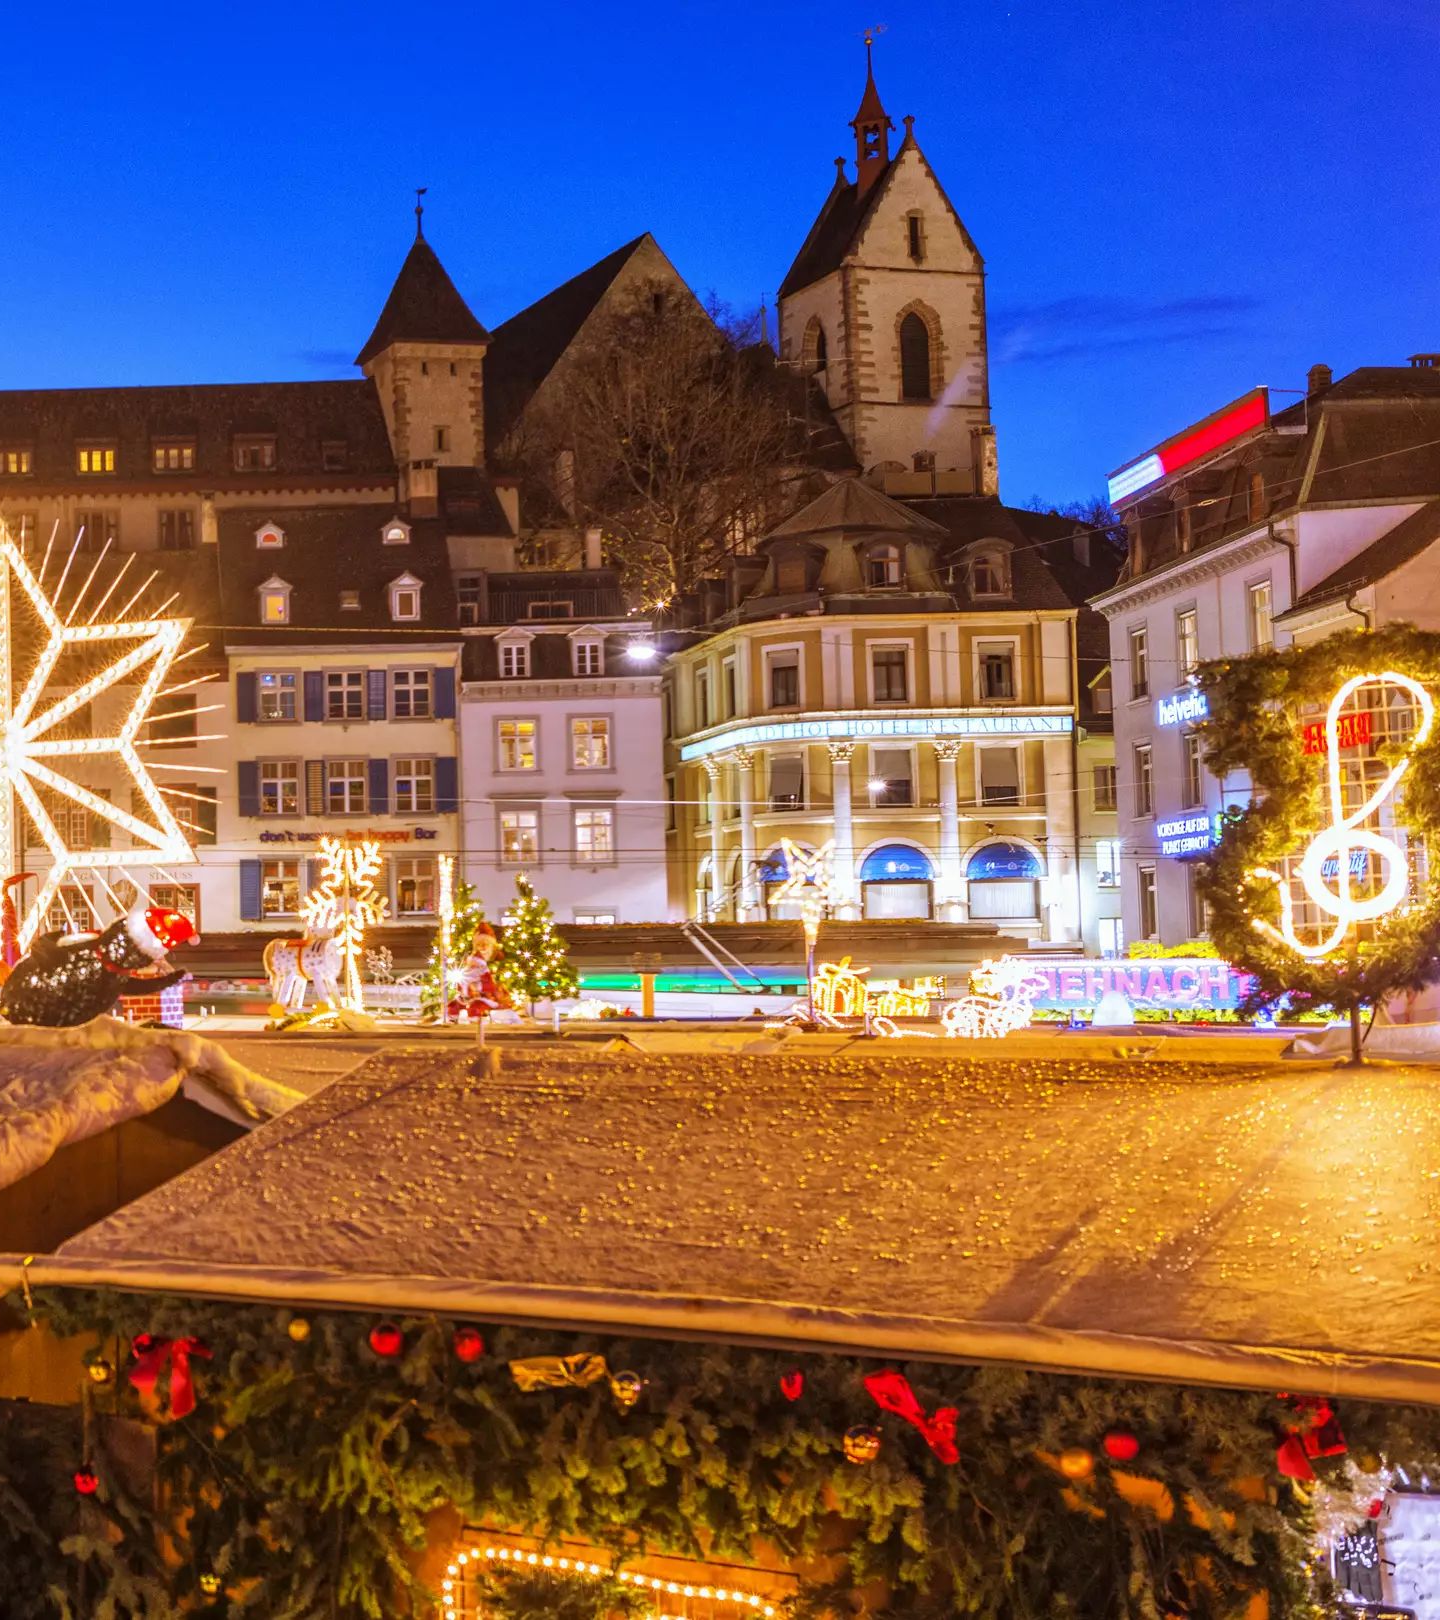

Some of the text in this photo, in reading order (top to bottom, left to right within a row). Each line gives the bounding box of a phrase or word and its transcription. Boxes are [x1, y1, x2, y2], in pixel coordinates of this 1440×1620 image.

[847, 718, 909, 735] HOTEL
[926, 717, 1066, 734] RESTAURANT
[414, 827, 437, 840] Bar
